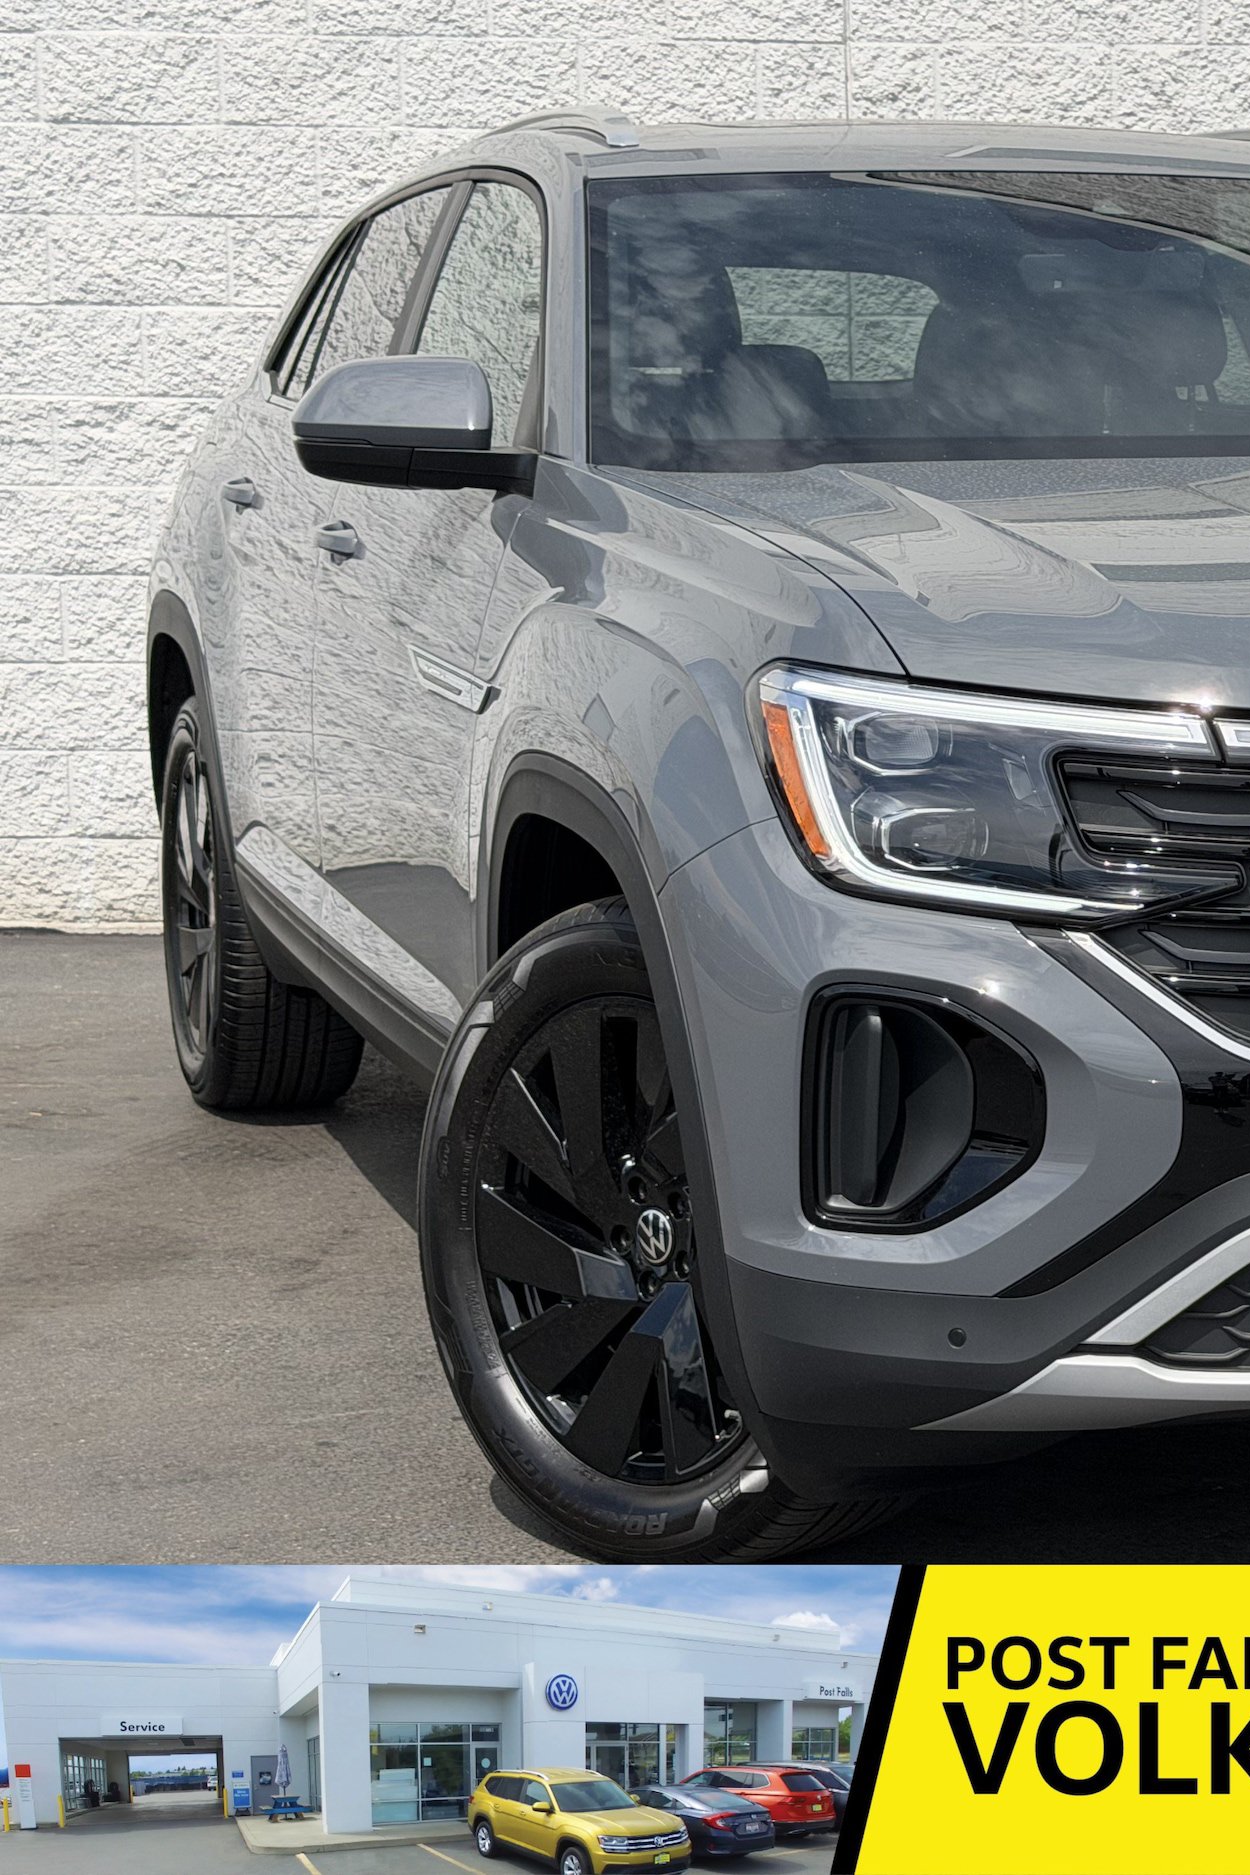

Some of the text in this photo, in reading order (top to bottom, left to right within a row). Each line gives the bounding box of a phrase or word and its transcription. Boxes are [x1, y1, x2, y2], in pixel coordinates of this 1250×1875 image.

[819, 1685, 853, 1698] Post Falls
[120, 1721, 165, 1732] Service
